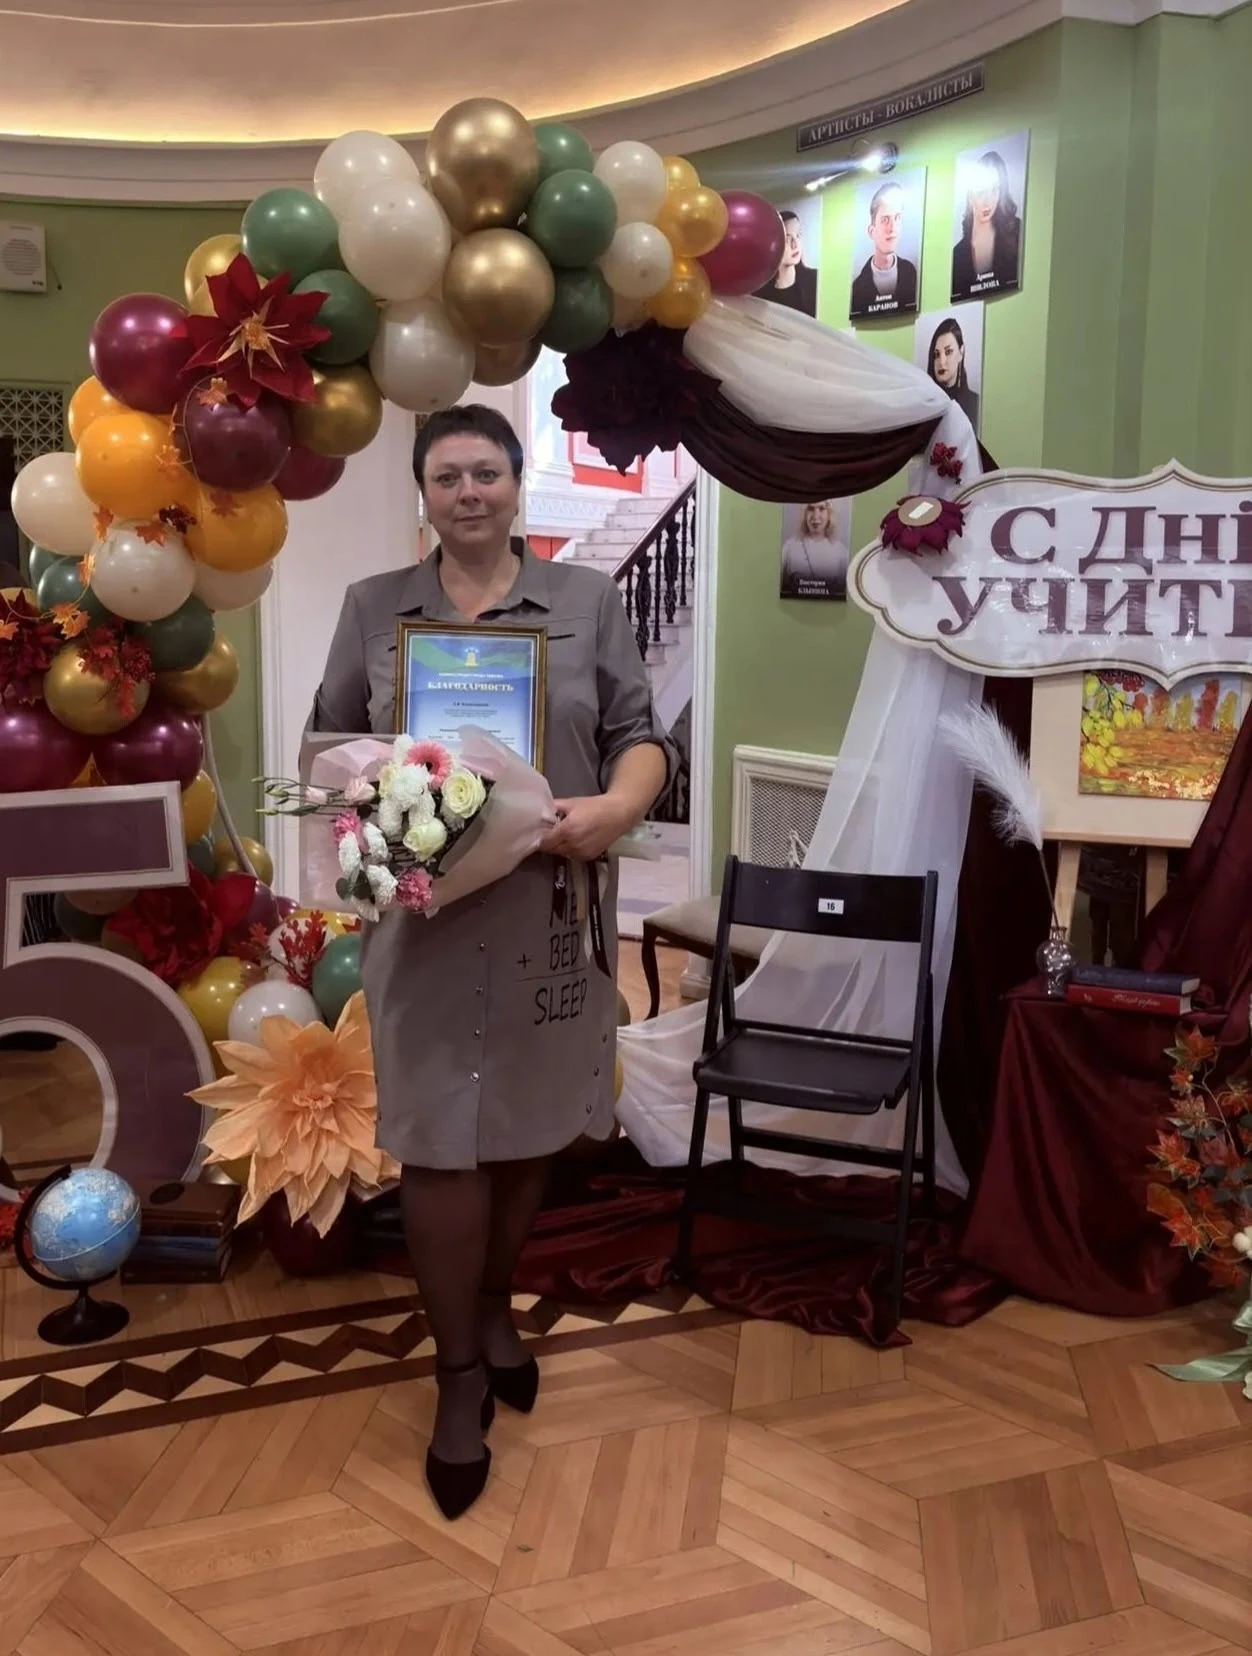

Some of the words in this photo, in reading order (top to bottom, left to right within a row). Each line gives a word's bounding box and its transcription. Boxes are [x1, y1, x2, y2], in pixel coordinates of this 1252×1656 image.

[808, 110, 874, 143] АРТИСТЫ
[885, 72, 973, 118] ВОКАЛИСТЫ
[990, 506, 1056, 565] С
[427, 681, 514, 692] БЛАГОДАРНОСТЬ
[827, 902, 836, 911] 16
[549, 931, 580, 971] BED
[534, 978, 588, 1026] SLEEP
